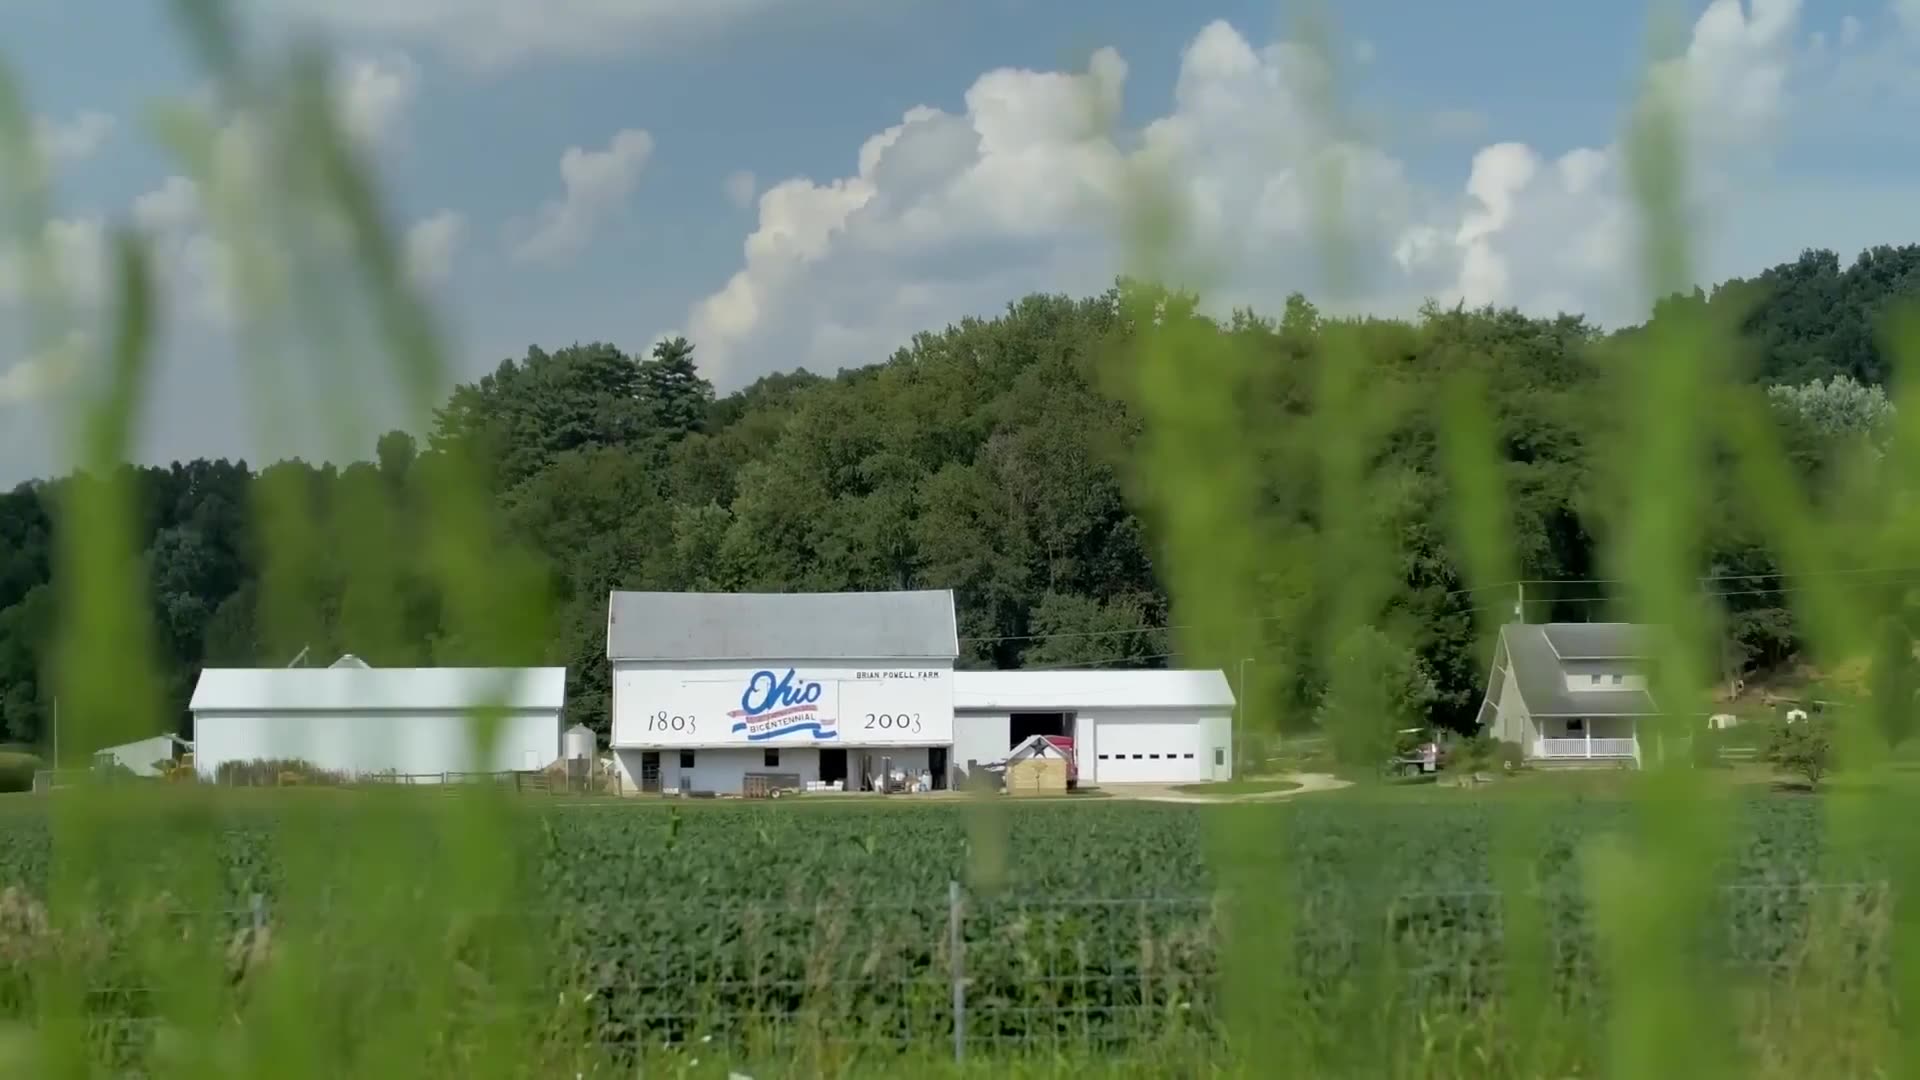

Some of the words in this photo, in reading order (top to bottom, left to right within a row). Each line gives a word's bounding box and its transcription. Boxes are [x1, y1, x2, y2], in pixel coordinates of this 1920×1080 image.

[856, 671, 880, 679] BRIAN
[883, 671, 914, 679] POWELL
[918, 671, 939, 679] FARM
[742, 668, 821, 715] Ohio
[648, 711, 696, 735] 1803
[750, 713, 816, 733] BICENTENNIAL
[864, 713, 921, 734] 2003
